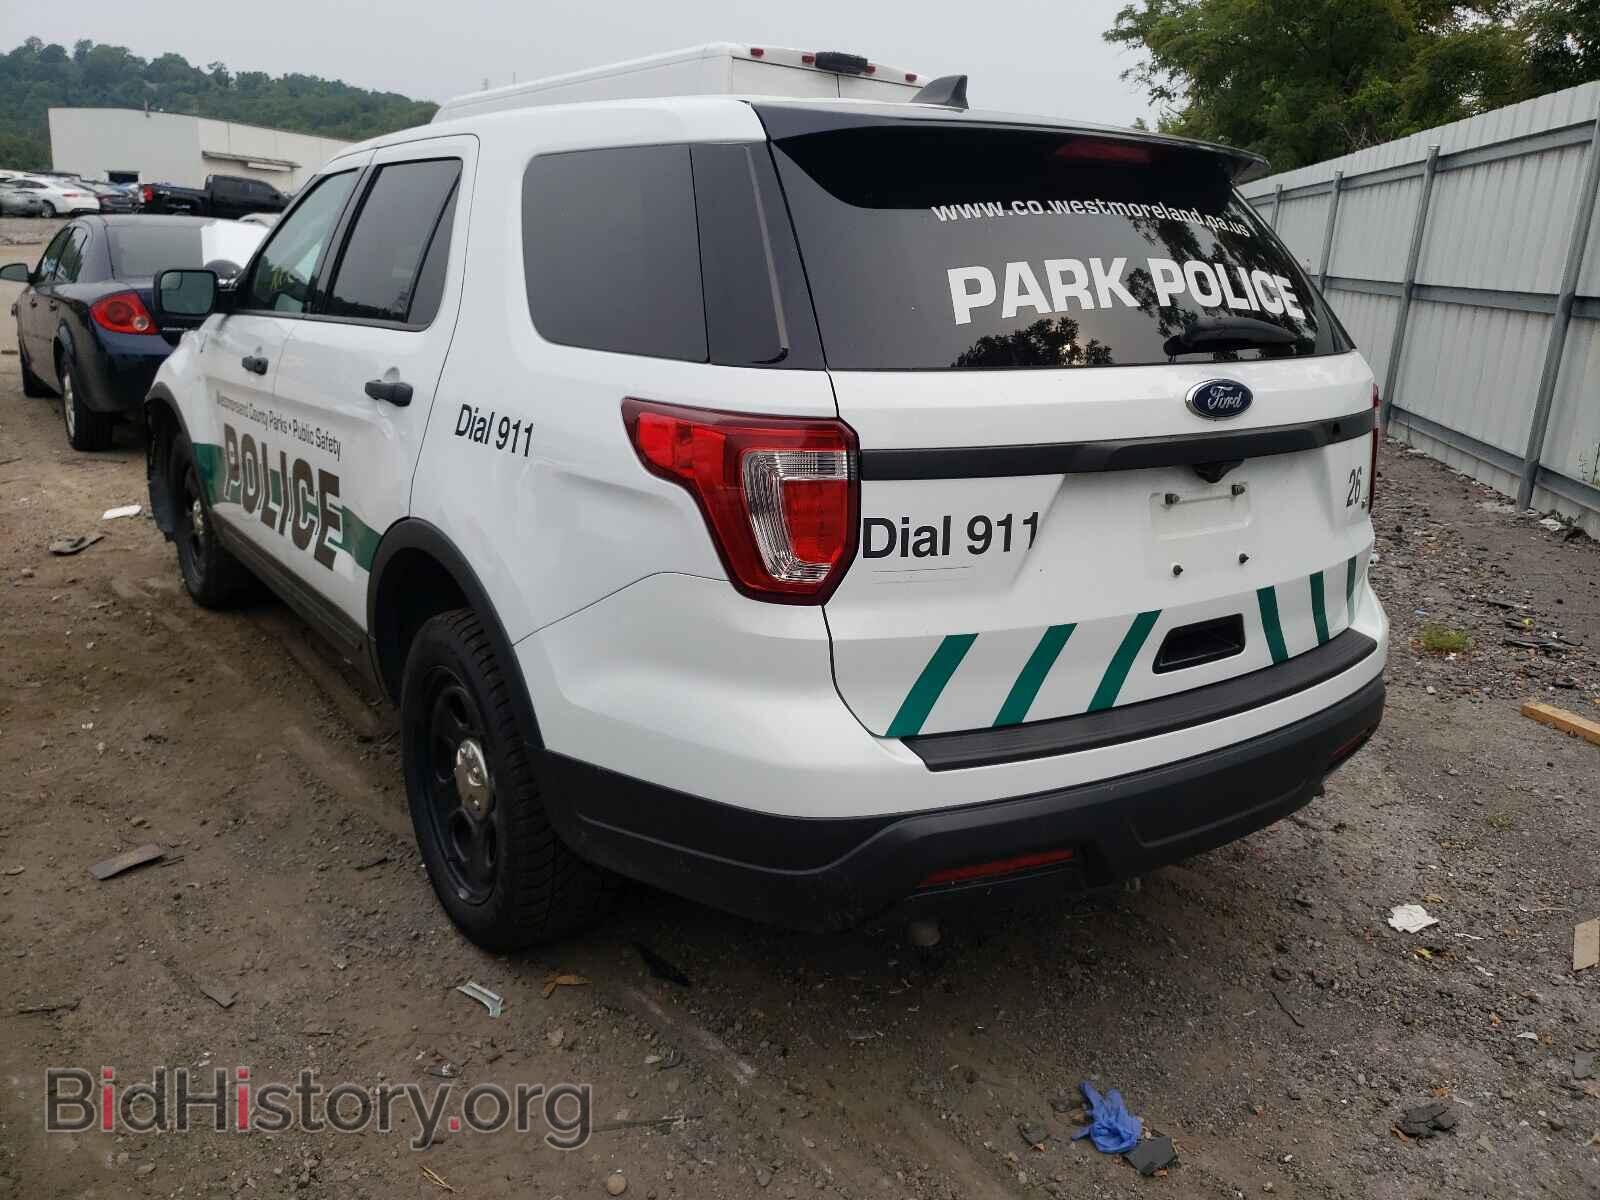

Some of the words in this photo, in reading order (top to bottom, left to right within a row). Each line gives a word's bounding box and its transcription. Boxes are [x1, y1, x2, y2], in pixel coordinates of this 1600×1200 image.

[931, 199, 1250, 238] www.co.westmoreland.pa.us
[947, 257, 1141, 326] PARK
[1147, 258, 1307, 321] POLICE
[1207, 385, 1243, 410] Ford
[269, 409, 288, 434] Parks
[293, 418, 314, 446] Public
[315, 427, 341, 464] Safety
[455, 403, 495, 445] Dial
[495, 416, 534, 457] 911
[223, 422, 343, 571] POLICE
[863, 515, 951, 559] Dial
[966, 511, 1039, 555] 911
